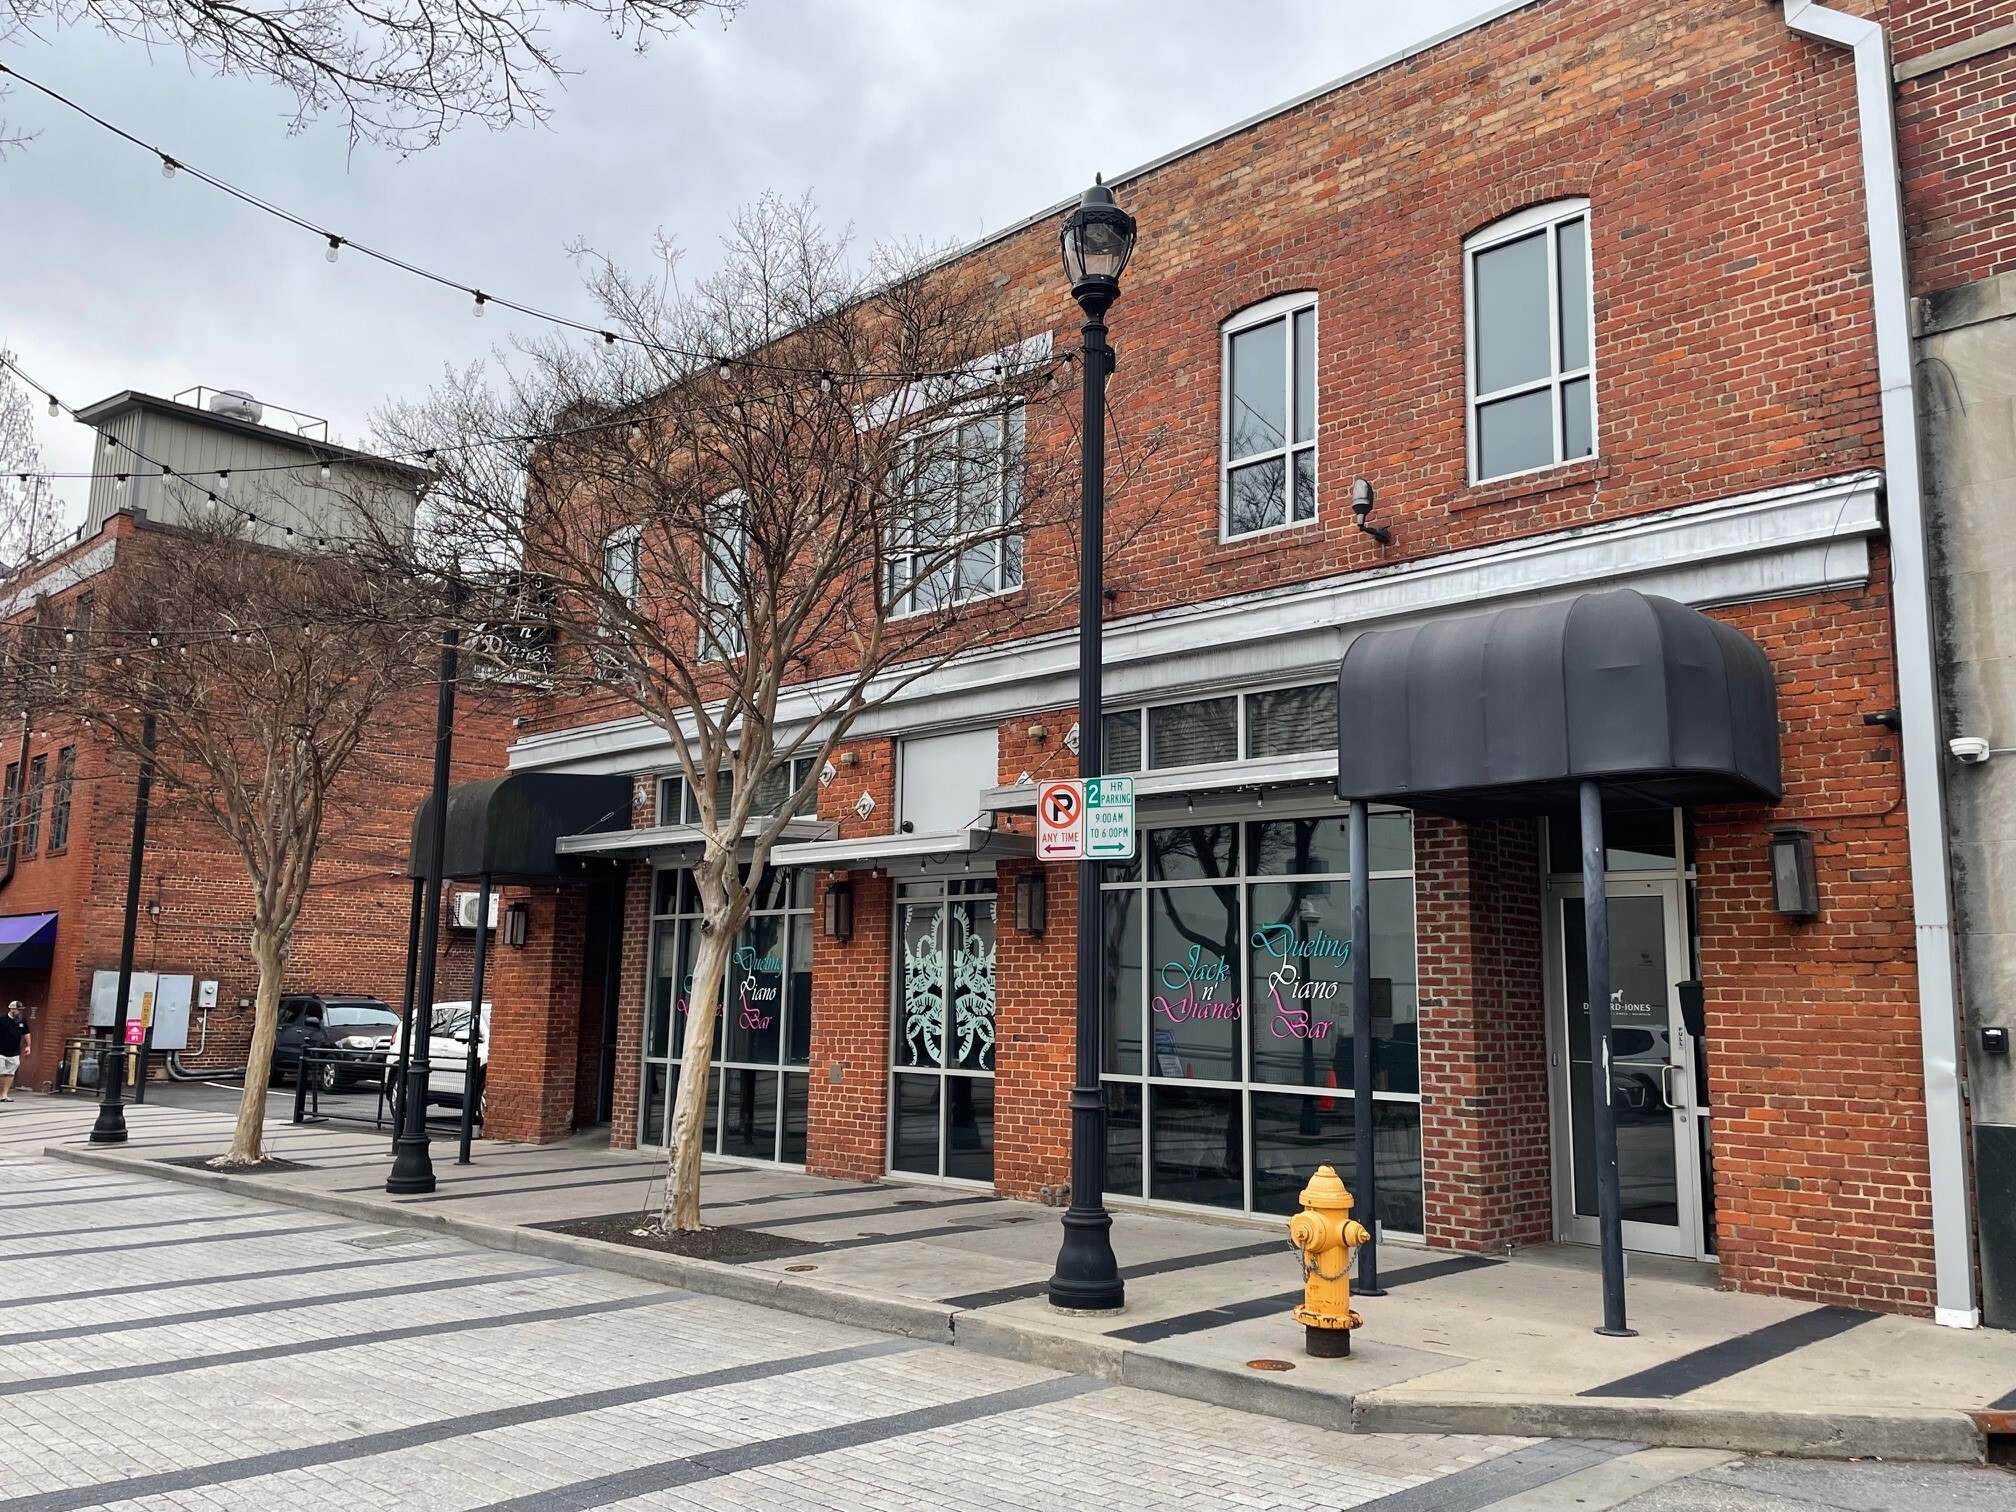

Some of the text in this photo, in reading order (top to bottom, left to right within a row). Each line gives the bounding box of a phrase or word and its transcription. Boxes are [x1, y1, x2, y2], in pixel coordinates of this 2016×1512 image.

[1088, 781, 1123, 804] 2 HR
[1101, 793, 1131, 805] PARKING
[1042, 832, 1080, 843] ANY TIME
[1090, 828, 1099, 839] TO
[1251, 922, 1352, 968] Dueling
[1160, 944, 1231, 990] Jack
[739, 974, 777, 1001] Piano
[1201, 983, 1219, 1001] n'
[1268, 963, 1339, 999] Piano
[739, 1003, 773, 1030] Bar
[1152, 984, 1241, 1024] Diane's
[1270, 998, 1333, 1039] Bar
